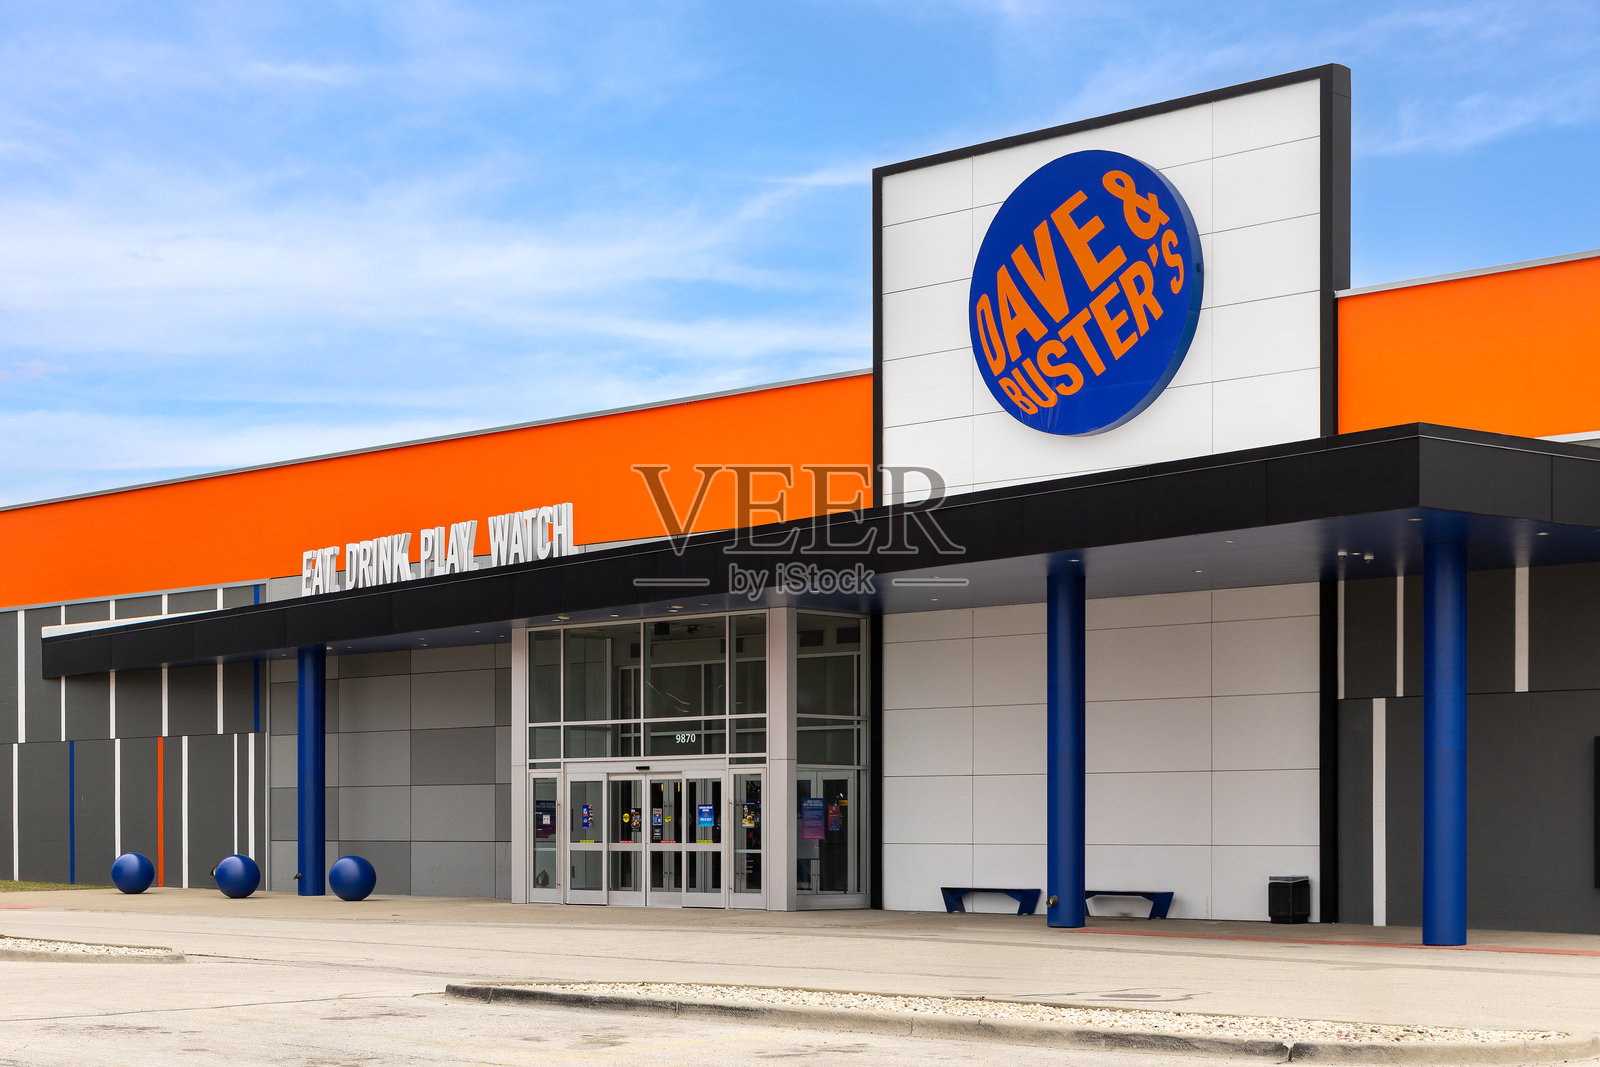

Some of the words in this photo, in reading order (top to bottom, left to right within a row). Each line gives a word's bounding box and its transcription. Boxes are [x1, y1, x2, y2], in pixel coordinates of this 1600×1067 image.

[976, 190, 1127, 377] DAVE
[1102, 170, 1170, 240] &
[998, 229, 1185, 415] BUSTER'S
[675, 733, 696, 744] 9870
